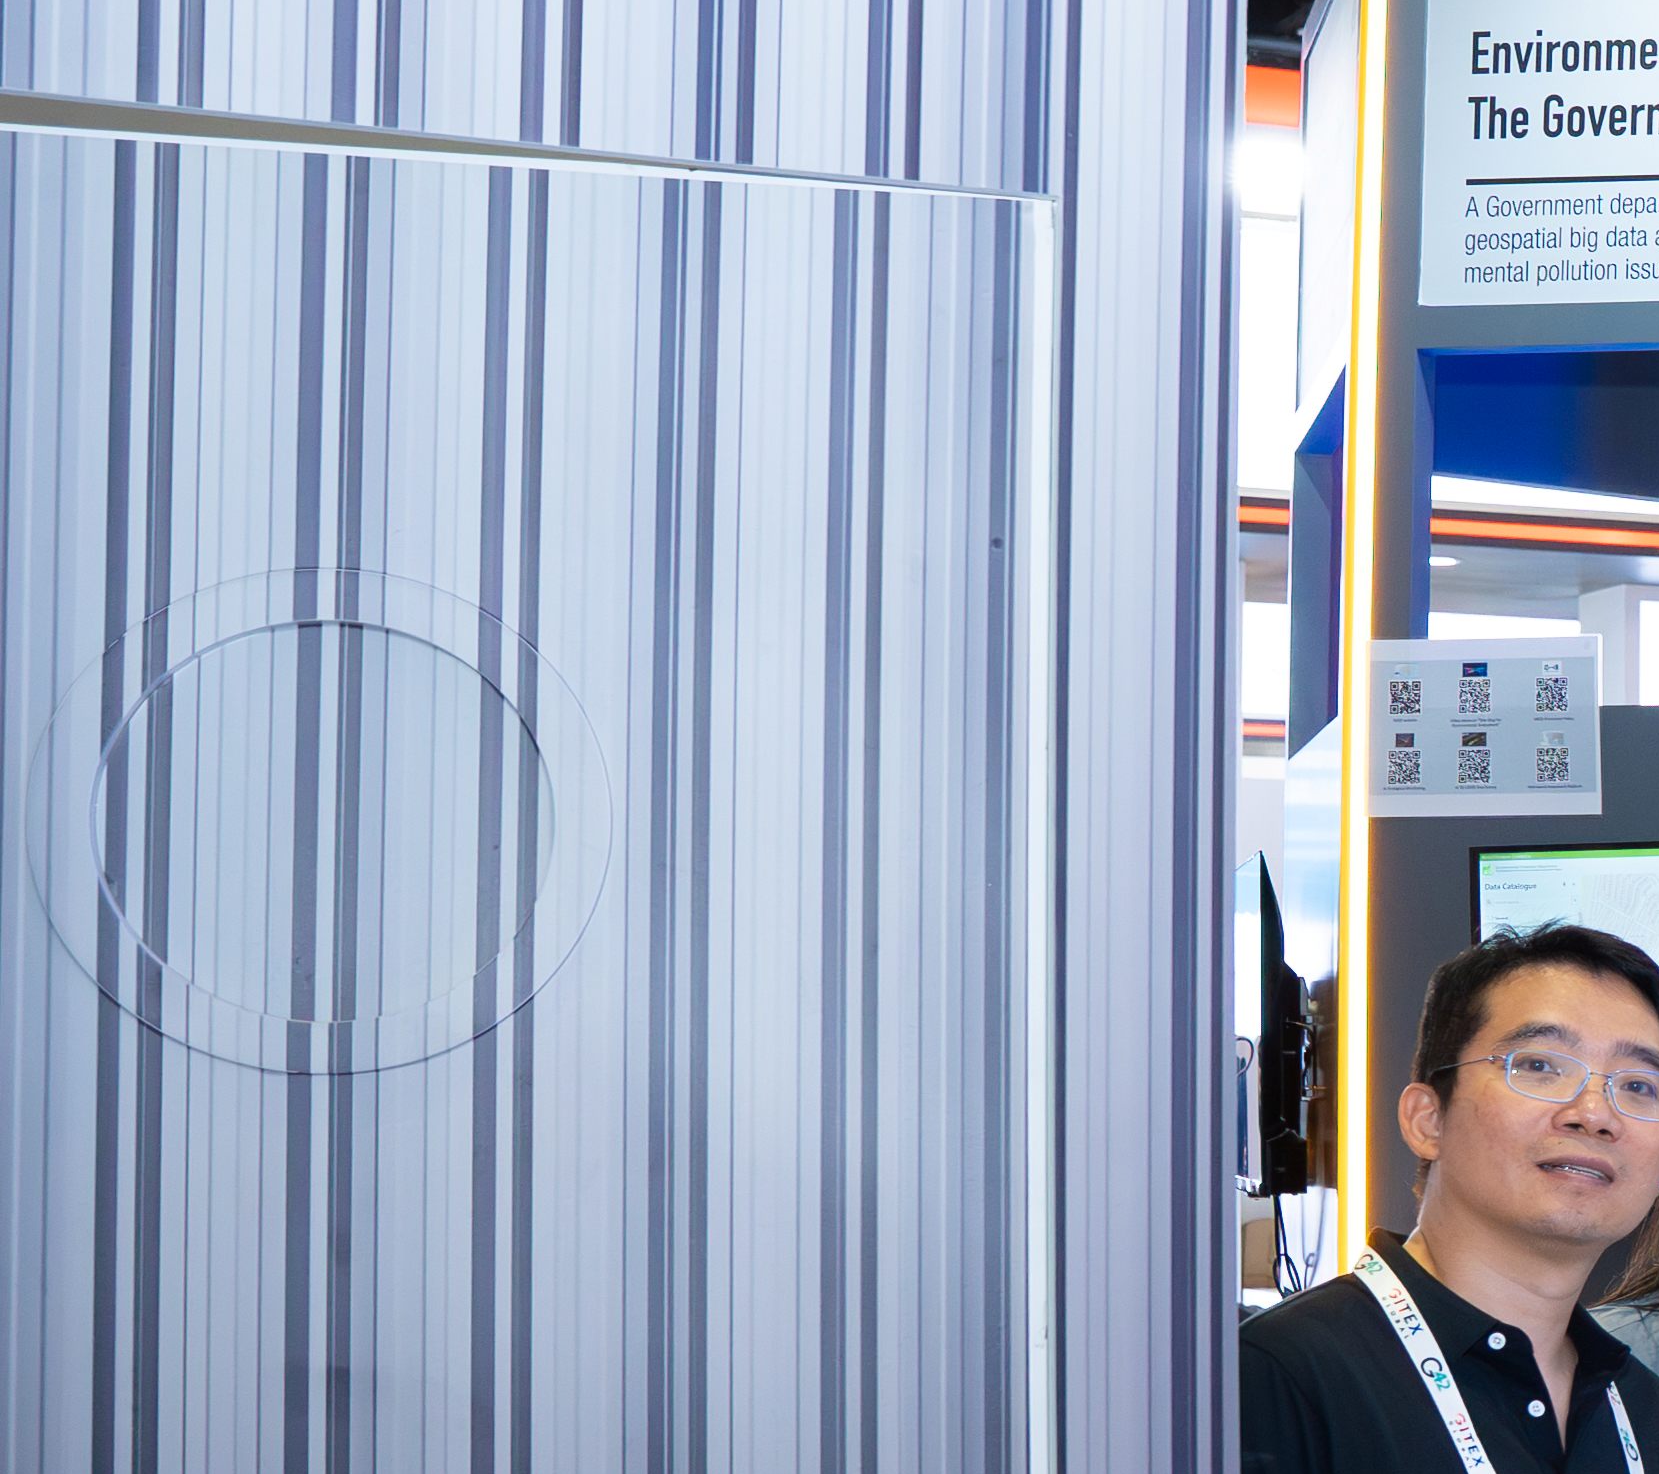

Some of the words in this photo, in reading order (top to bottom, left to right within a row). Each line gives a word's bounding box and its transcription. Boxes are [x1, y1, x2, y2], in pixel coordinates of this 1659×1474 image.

[1468, 97, 1528, 140] The
[1465, 198, 1478, 218] A
[1487, 196, 1601, 218] Government
[1465, 228, 1561, 256] geospatial
[1571, 228, 1597, 253] big
[1607, 226, 1647, 248] data
[1465, 262, 1528, 284] mental
[1537, 260, 1616, 287] pollution
